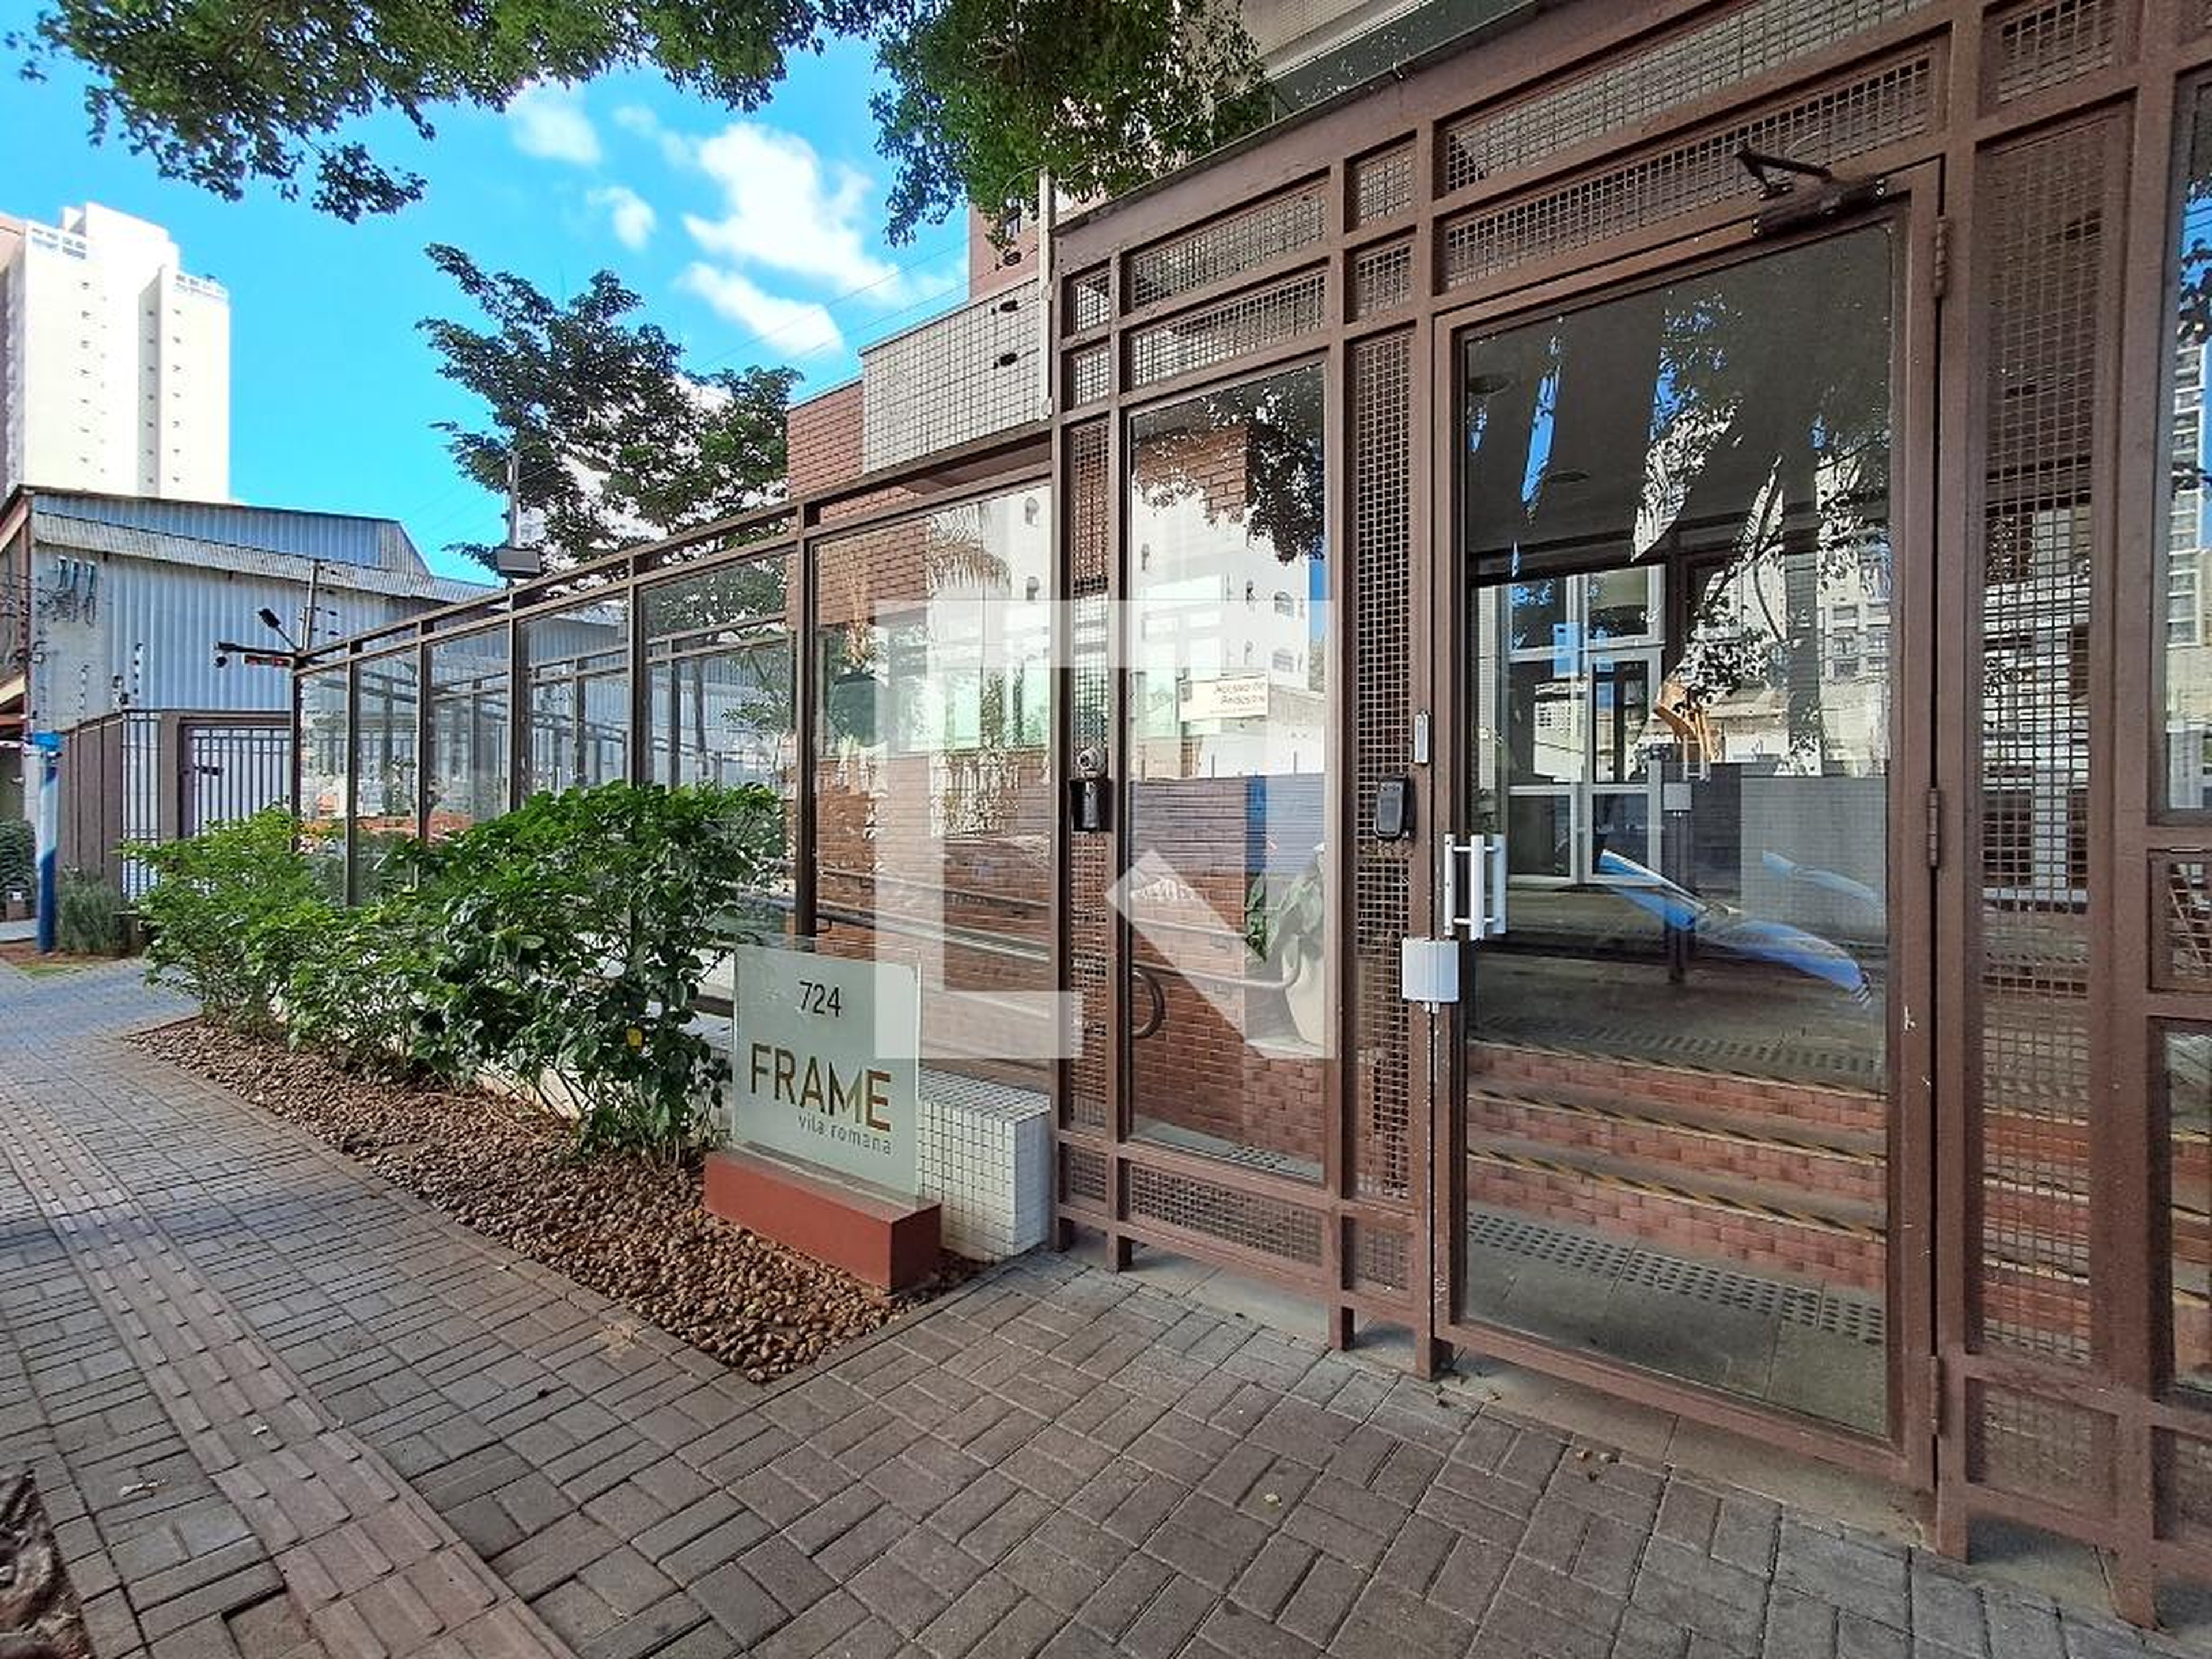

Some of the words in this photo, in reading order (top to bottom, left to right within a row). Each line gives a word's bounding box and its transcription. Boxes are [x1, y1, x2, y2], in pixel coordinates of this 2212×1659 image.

[798, 980, 842, 1018] 724
[750, 1043, 892, 1132] FRAME
[798, 1112, 824, 1135] vila
[831, 1124, 891, 1155] romana
